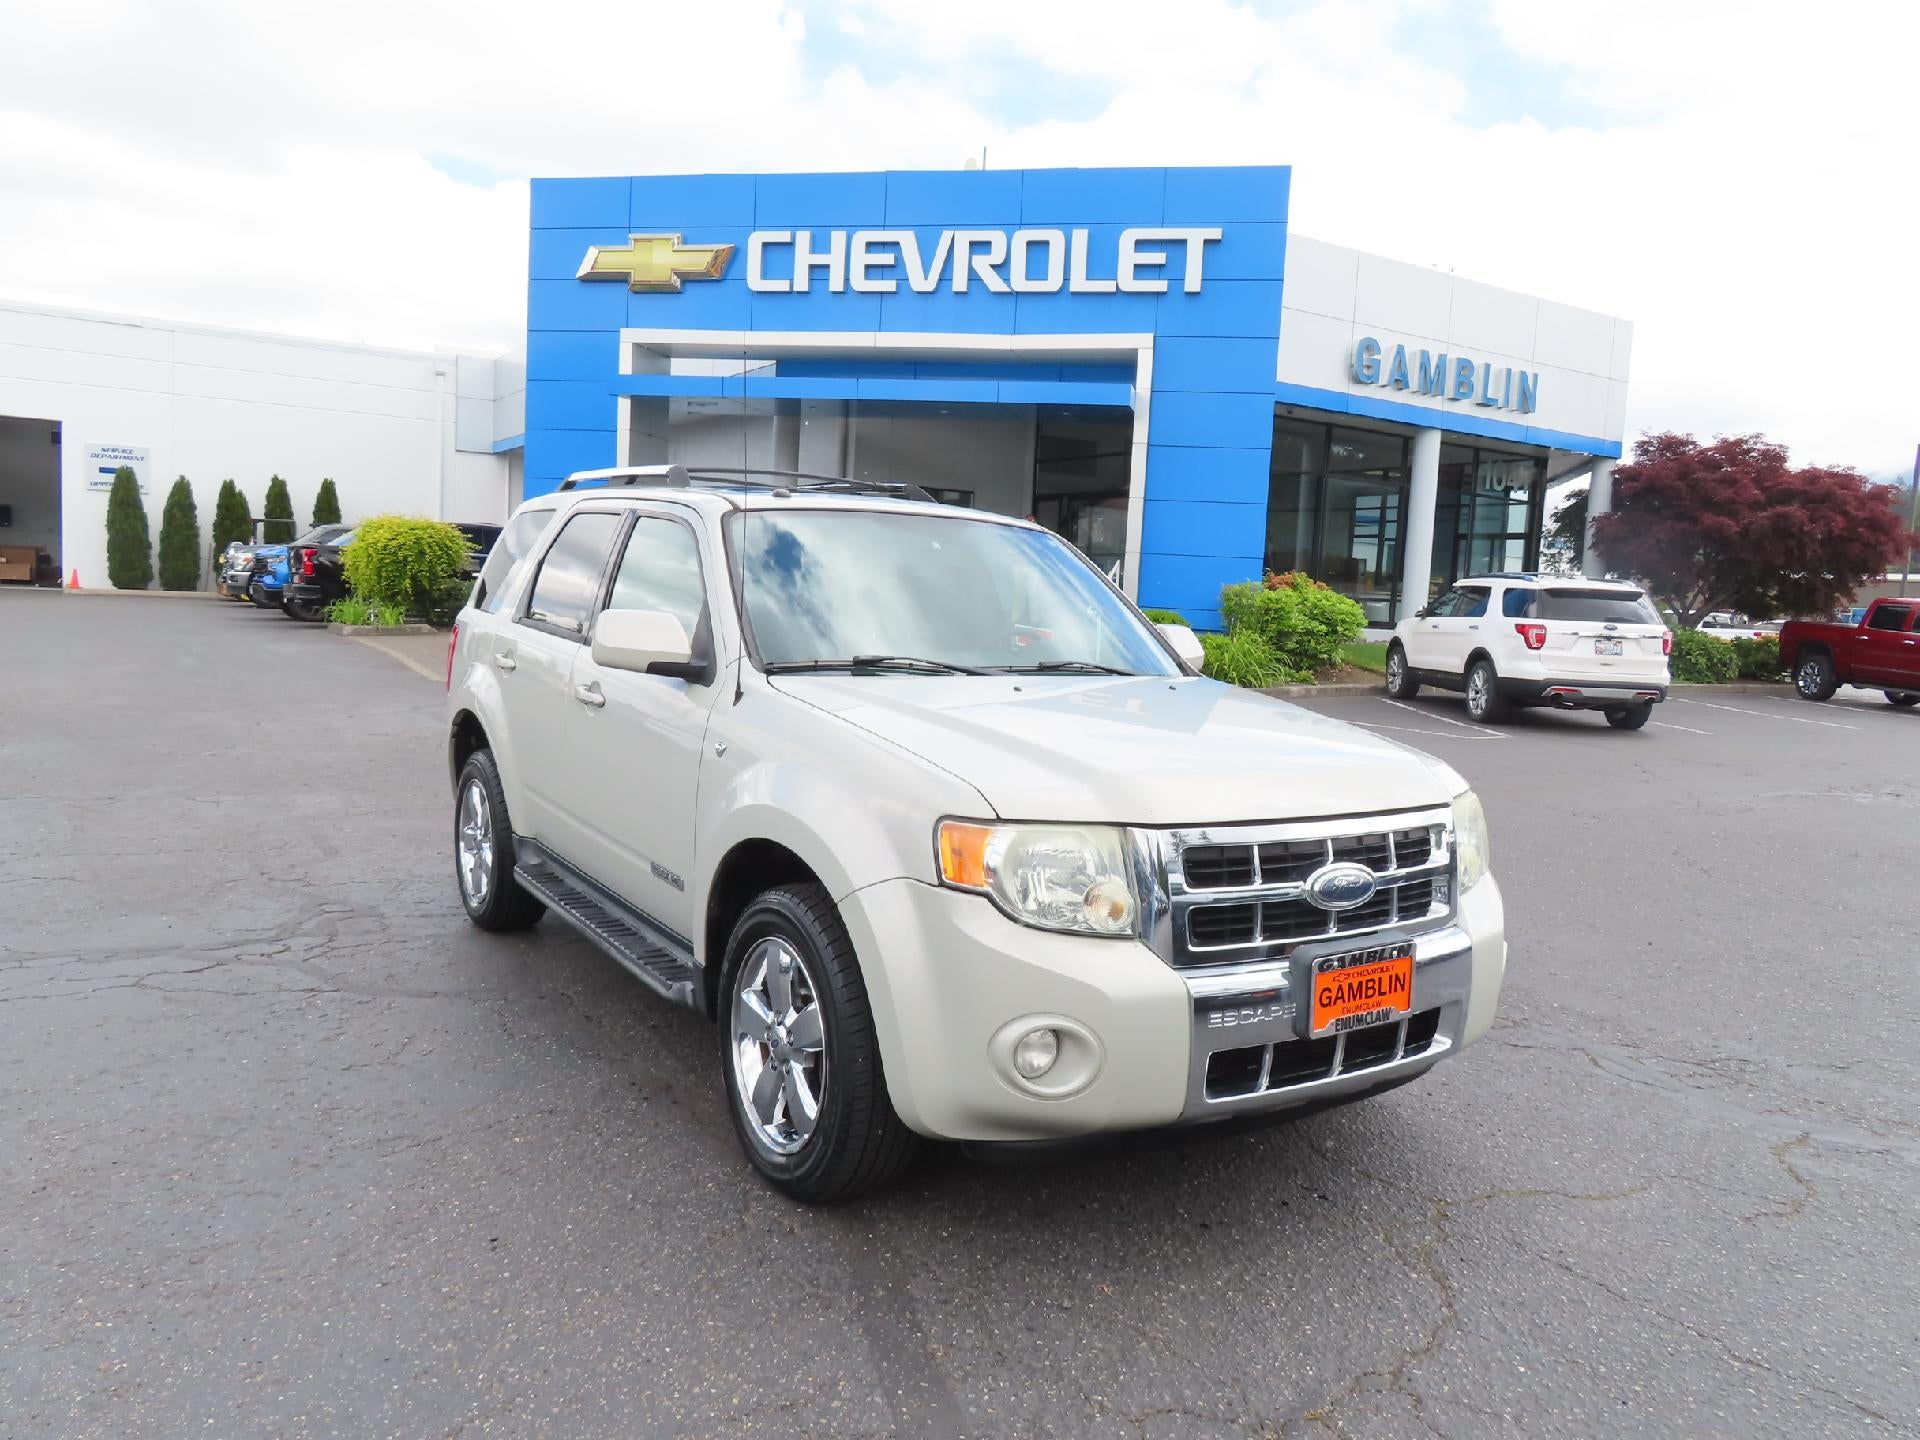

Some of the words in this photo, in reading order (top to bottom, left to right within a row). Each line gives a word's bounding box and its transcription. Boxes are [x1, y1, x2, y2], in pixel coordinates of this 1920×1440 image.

[746, 228, 1222, 294] CHEVROLET
[1351, 336, 1539, 415] GAMBLIN
[90, 452, 145, 462] DEPARTMENT
[1352, 964, 1396, 979] CHEVROLET
[1319, 972, 1407, 1009] GAMBLIN
[1207, 1003, 1297, 1029] ESCAPE
[1334, 1006, 1392, 1033] ENUMCLAW
[1341, 999, 1383, 1015] ENUMCLAW
